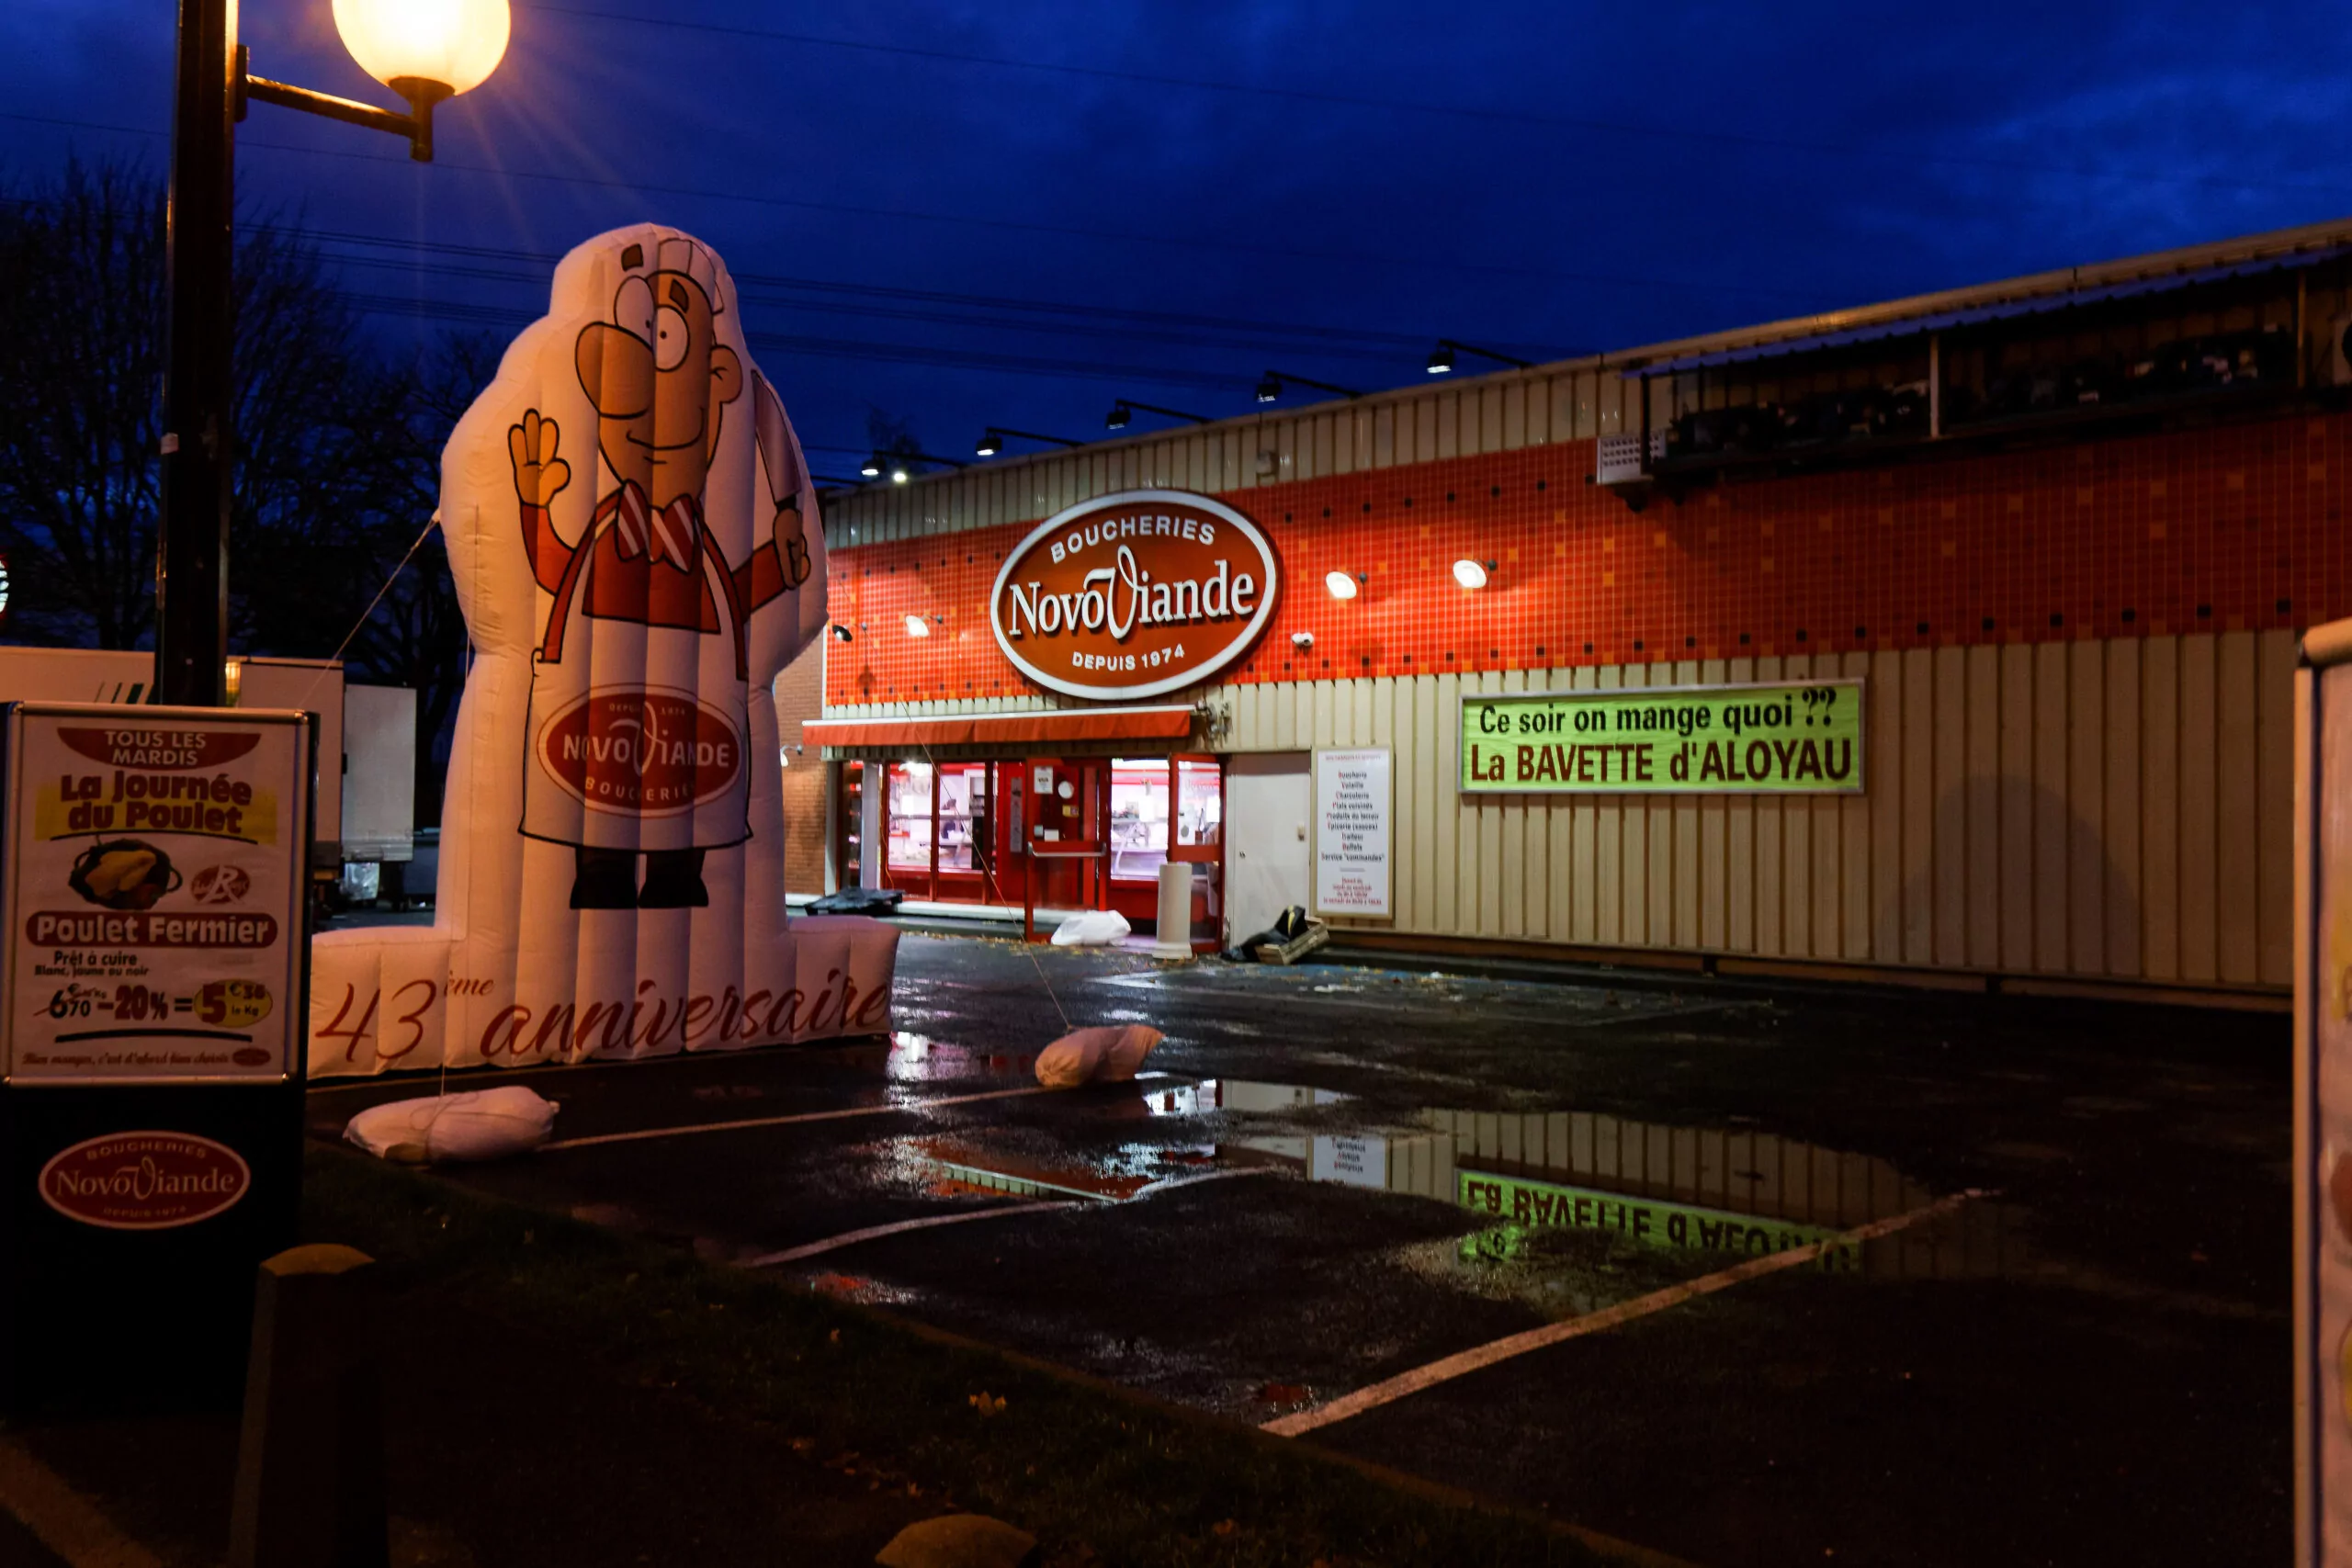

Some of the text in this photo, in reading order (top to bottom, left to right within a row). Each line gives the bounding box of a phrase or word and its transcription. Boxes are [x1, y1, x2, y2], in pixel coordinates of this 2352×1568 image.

[1050, 515, 1216, 564] BOUCHERIES
[1071, 643, 1185, 671] DEPUIS 1974
[1479, 687, 1837, 736] Ce soir on mange quoi ??
[104, 730, 207, 749] TOUS LES
[111, 749, 198, 766] MARDIS
[1471, 739, 1851, 783] La BAVETTE d'ALOYAU
[61, 774, 101, 802] La
[69, 801, 243, 834] du Poulet
[36, 915, 269, 944] Poulet Fermier
[54, 951, 83, 964] Prêt
[101, 952, 137, 965] cuire
[315, 978, 438, 1063] 43
[480, 968, 888, 1059] anniversaire
[85, 1140, 208, 1161] BOUCHERIES
